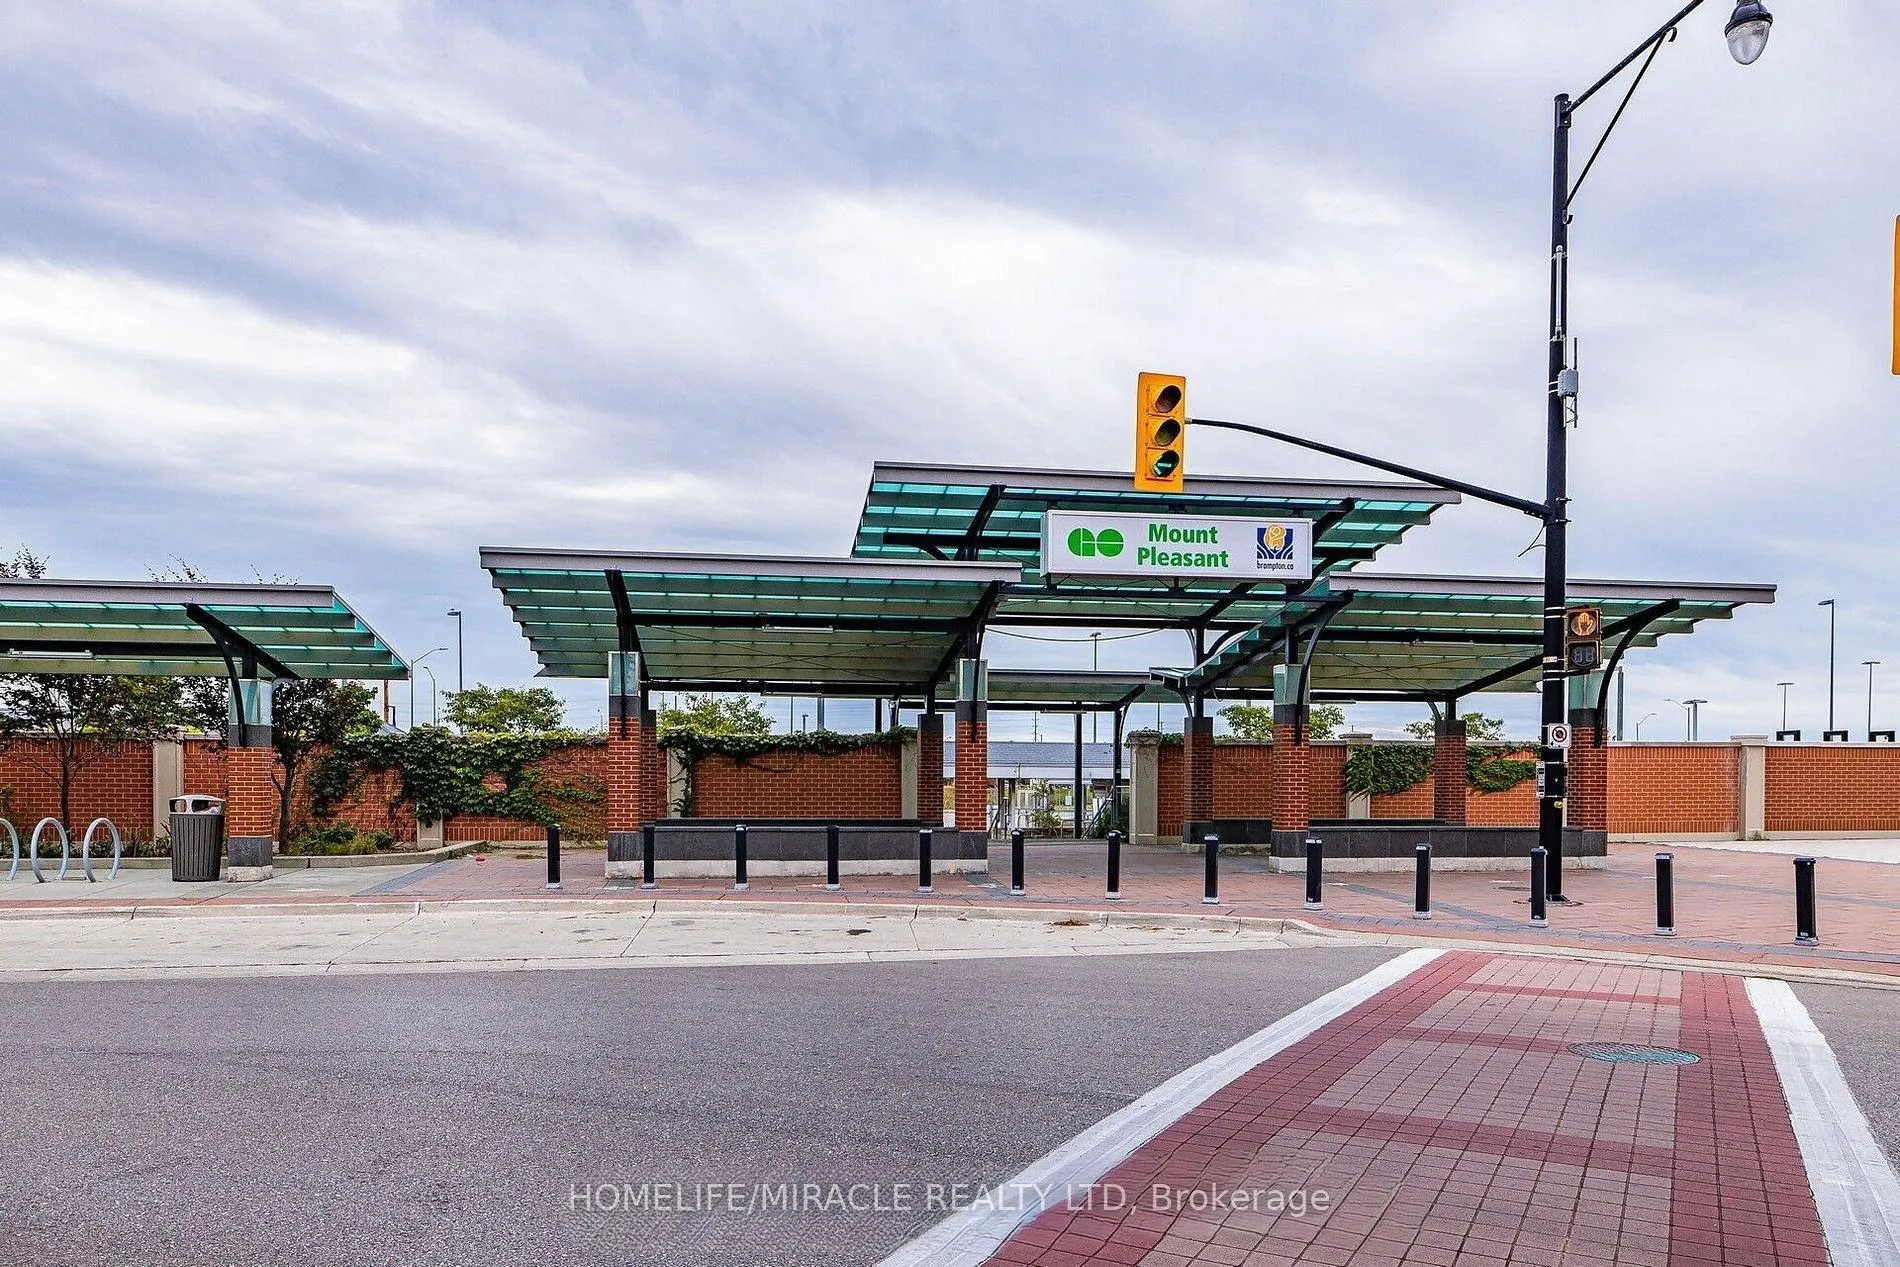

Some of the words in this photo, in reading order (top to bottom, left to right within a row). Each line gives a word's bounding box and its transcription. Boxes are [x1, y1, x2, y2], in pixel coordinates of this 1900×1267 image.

[1148, 523, 1218, 544] Mount
[1137, 546, 1229, 568] Pleasant
[1256, 560, 1294, 571] brampton.ca
